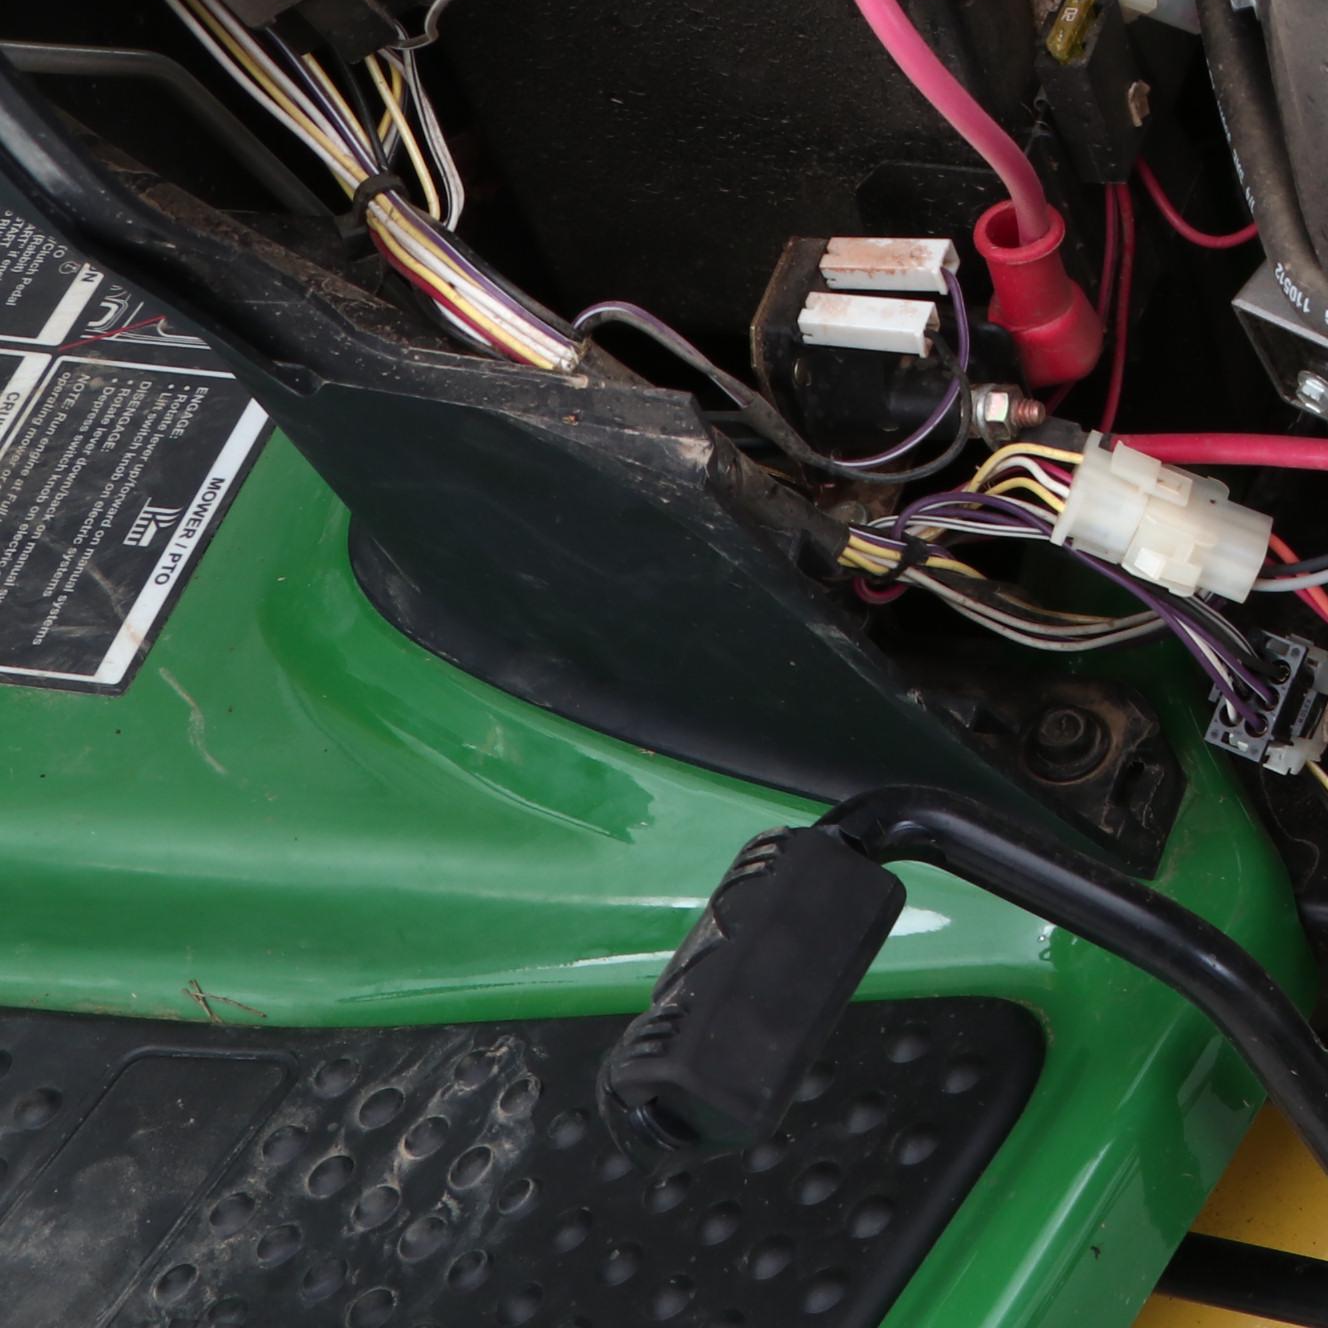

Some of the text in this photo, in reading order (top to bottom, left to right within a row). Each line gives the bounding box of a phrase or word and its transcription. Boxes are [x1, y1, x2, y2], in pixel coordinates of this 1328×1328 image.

[10, 234, 45, 272] (Rabbit)
[5, 277, 33, 306] Pedal
[1273, 261, 1312, 313] 110512
[32, 372, 72, 426] operating
[66, 374, 91, 410] NOTE:
[100, 380, 152, 452] DISENGAGE:
[170, 386, 210, 439] ENGAGE:
[9, 428, 38, 466] mower
[48, 413, 68, 436] Run
[0, 469, 13, 483] or
[0, 386, 115, 568] Depress switch knob on electric
[20, 437, 50, 476] engine
[4, 388, 132, 587] Rotate lever down/back on manual
[14, 478, 28, 492] at
[42, 392, 171, 598] Lift switch knob on electric systems
[32, 393, 188, 646] Rotate lever up/forward on manual systems
[154, 477, 226, 586] MOWER PTO
